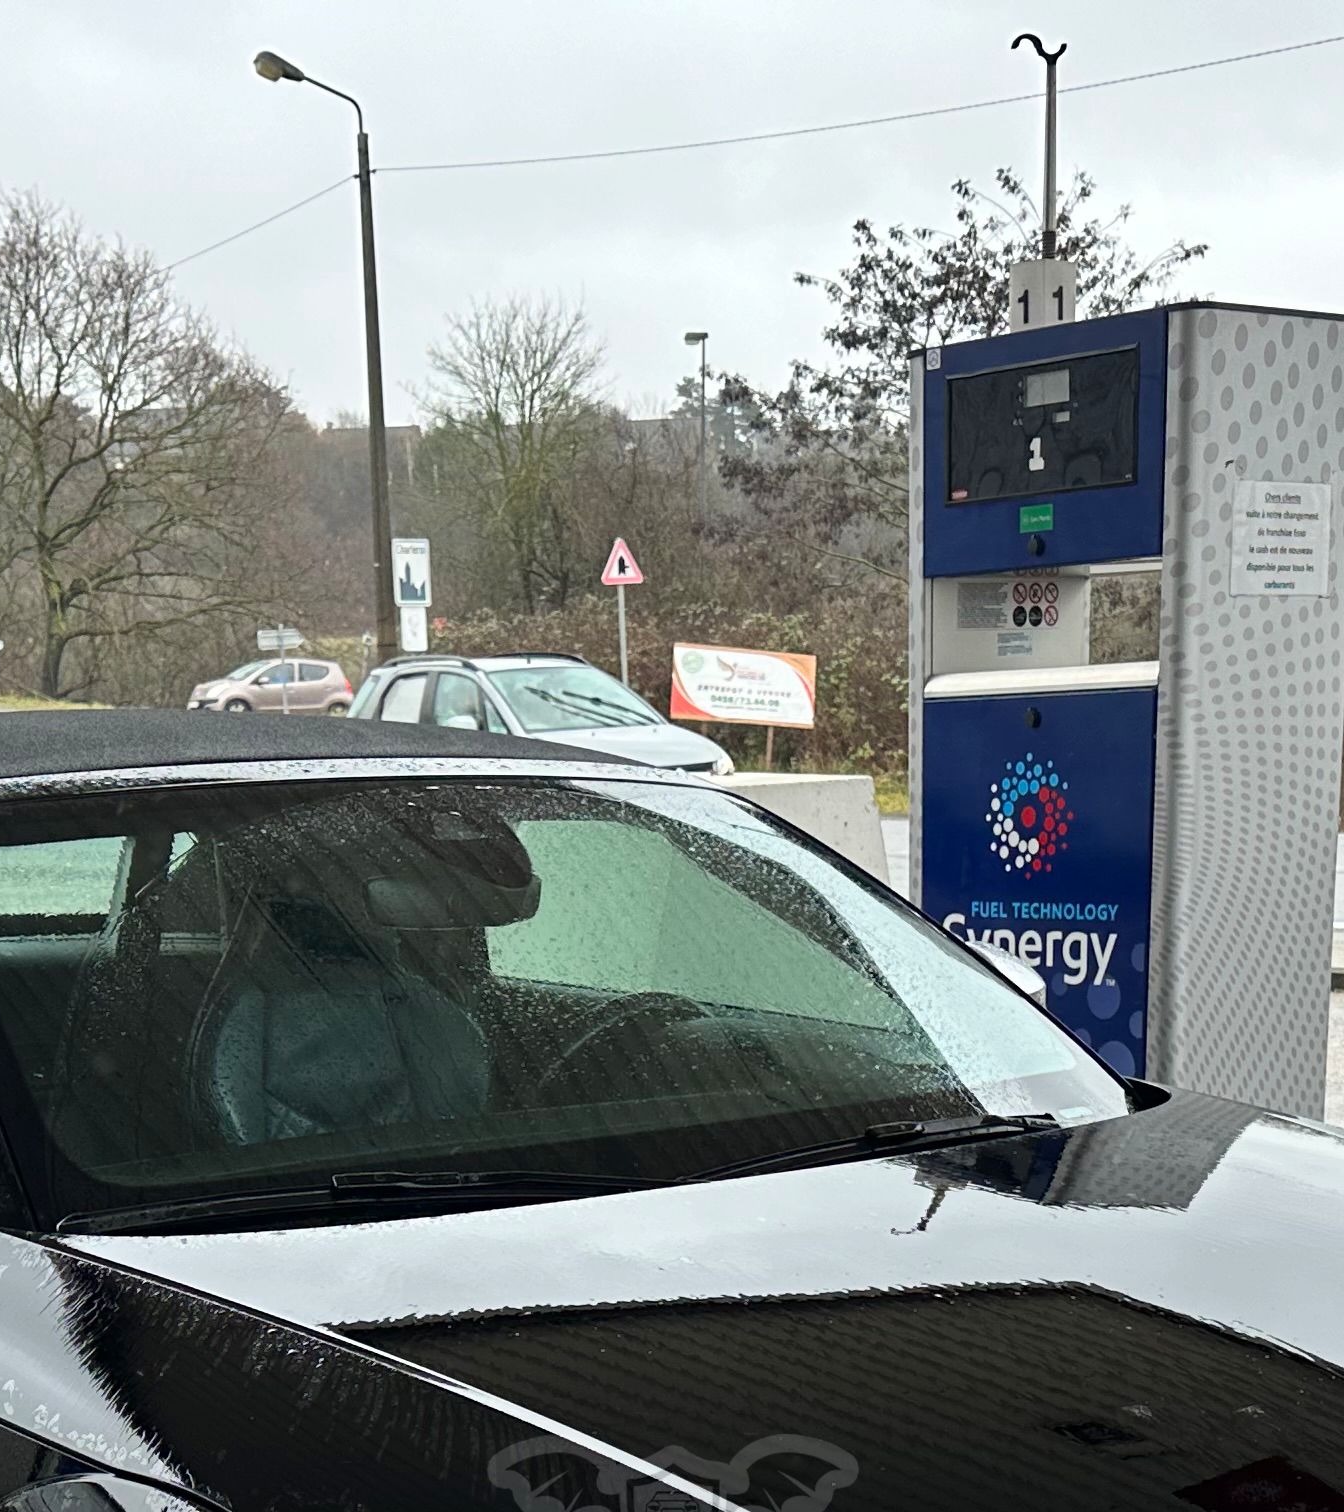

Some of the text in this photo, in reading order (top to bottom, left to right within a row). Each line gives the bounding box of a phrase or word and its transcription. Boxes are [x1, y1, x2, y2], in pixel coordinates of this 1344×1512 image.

[1018, 289, 1029, 324] 1
[1052, 285, 1063, 320] 1
[1028, 437, 1045, 471] 1
[971, 901, 1118, 921] FUEL TECHNOLOGY
